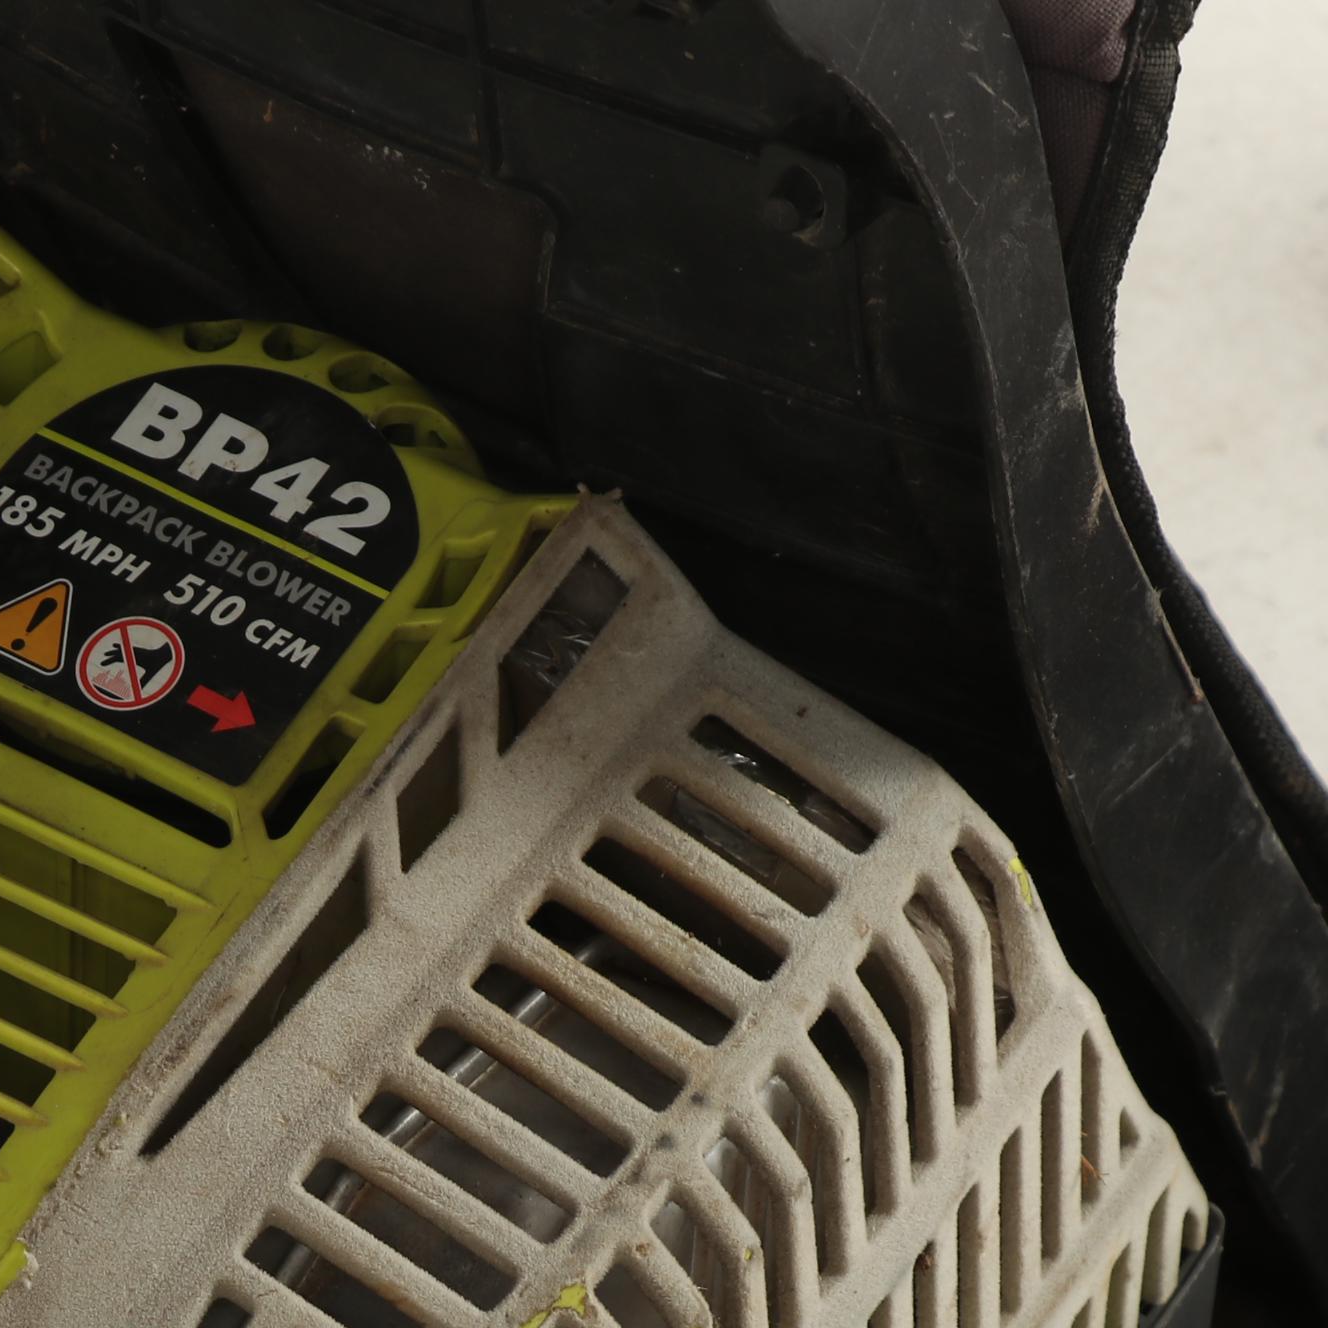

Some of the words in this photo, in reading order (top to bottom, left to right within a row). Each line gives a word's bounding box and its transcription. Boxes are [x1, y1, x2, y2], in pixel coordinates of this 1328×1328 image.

[23, 453, 208, 556] BACKPACK
[205, 539, 352, 627] BLOWER
[110, 381, 391, 557] BP42
[59, 529, 151, 584] MPH
[163, 573, 247, 627] 510
[244, 618, 321, 670] CFM
